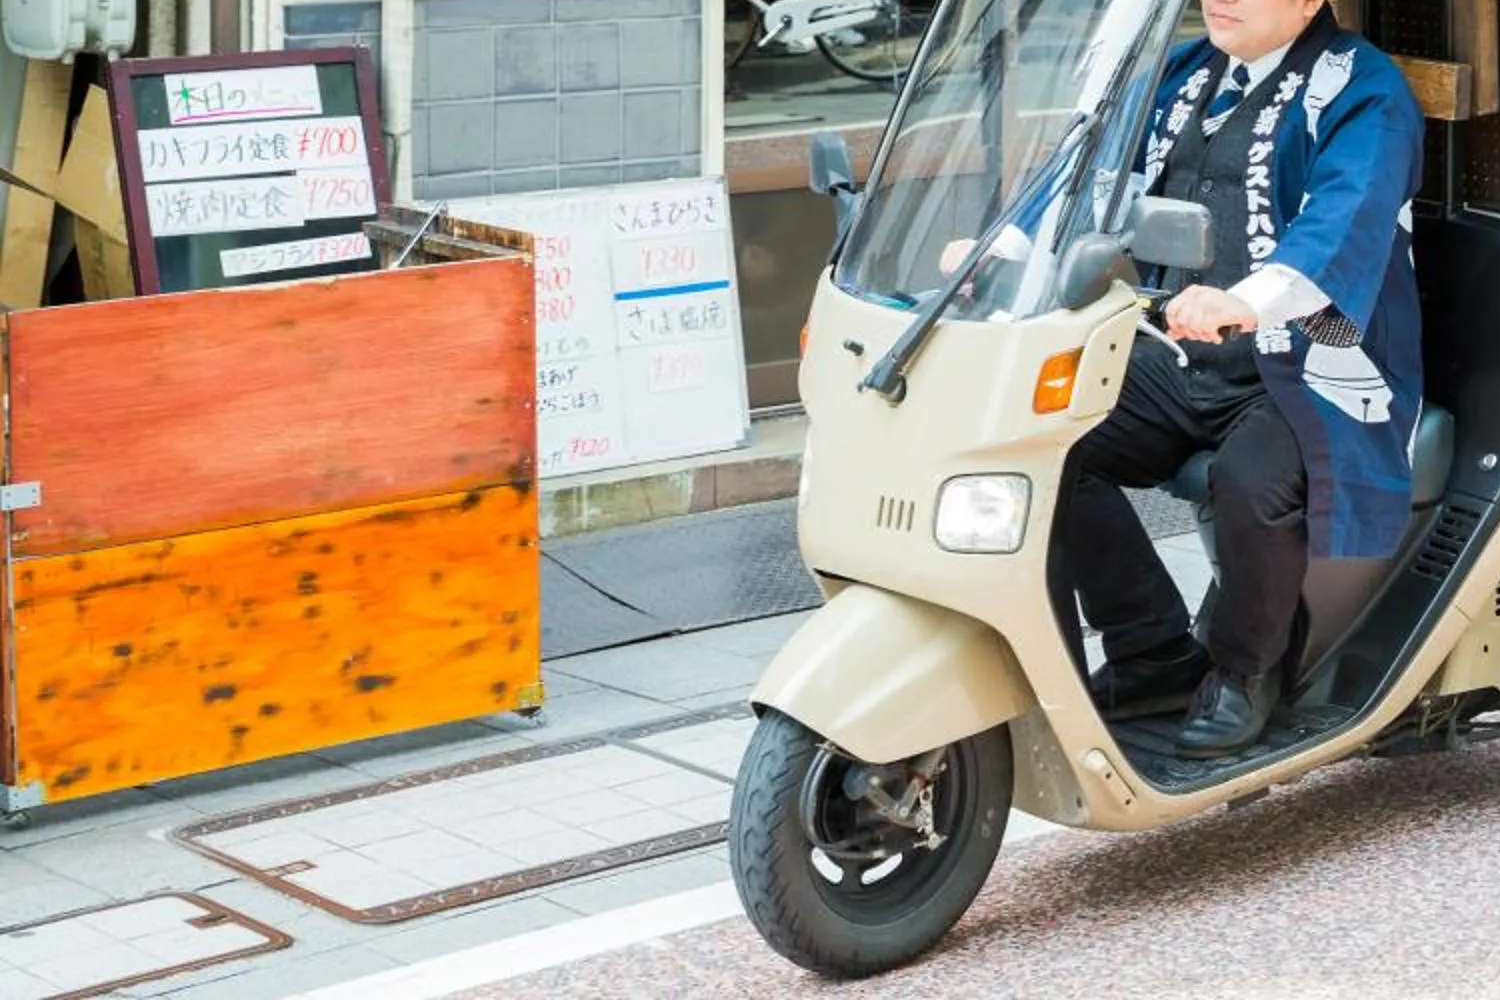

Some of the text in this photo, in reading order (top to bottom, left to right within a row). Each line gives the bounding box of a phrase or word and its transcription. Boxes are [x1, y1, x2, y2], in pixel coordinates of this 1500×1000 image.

[148, 125, 358, 167] カキフライ定食 ¥700
[303, 174, 370, 213] ¥750
